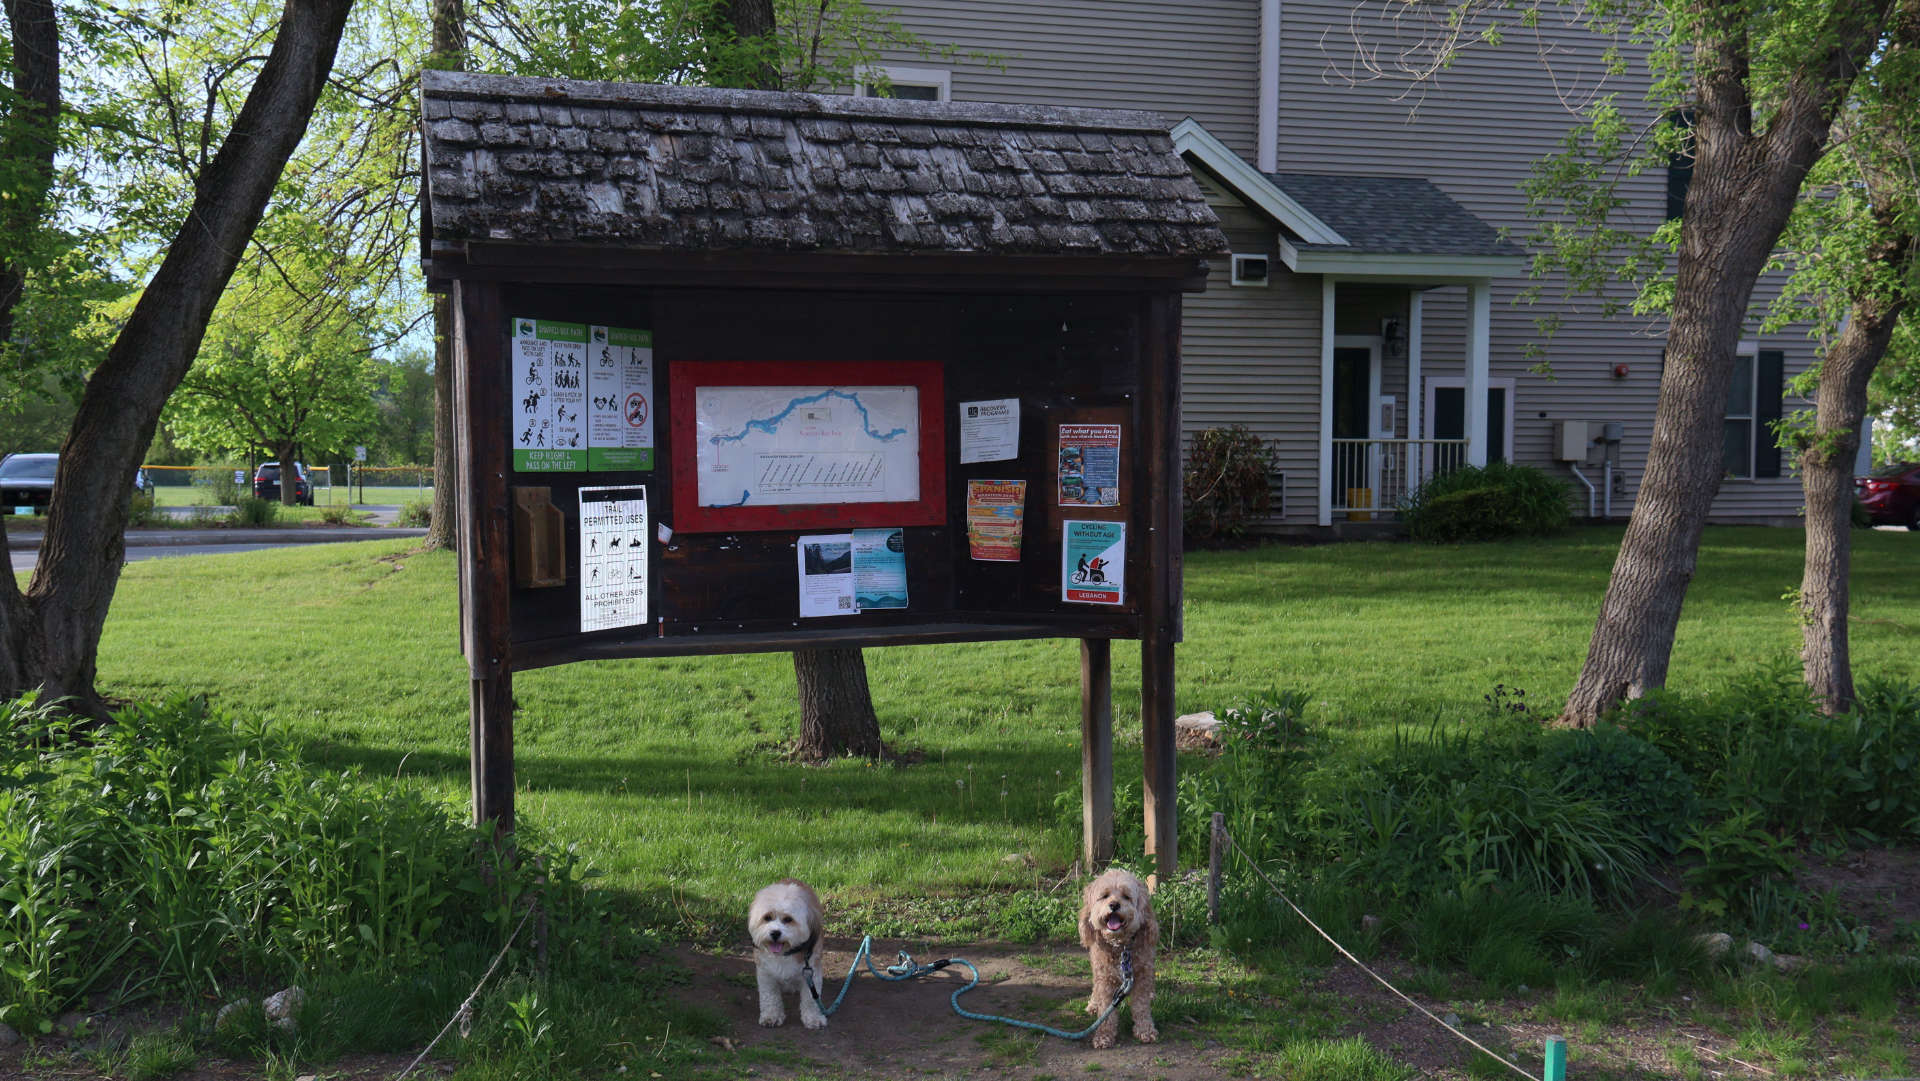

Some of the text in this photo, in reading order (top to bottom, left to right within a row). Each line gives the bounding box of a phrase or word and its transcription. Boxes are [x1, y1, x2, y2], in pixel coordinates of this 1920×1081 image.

[529, 451, 544, 459] KEEP
[552, 461, 563, 470] THE
[564, 461, 577, 470] LEFT
[972, 485, 1020, 494] SPANISH
[605, 505, 623, 513] TRAIL
[584, 513, 644, 526] PERMITTED USES
[1081, 523, 1107, 531] CYCLING
[1073, 530, 1101, 538] WITHOUT
[600, 590, 624, 600] OTHER
[626, 588, 643, 597] USES
[593, 597, 635, 608] PROHIBITED
